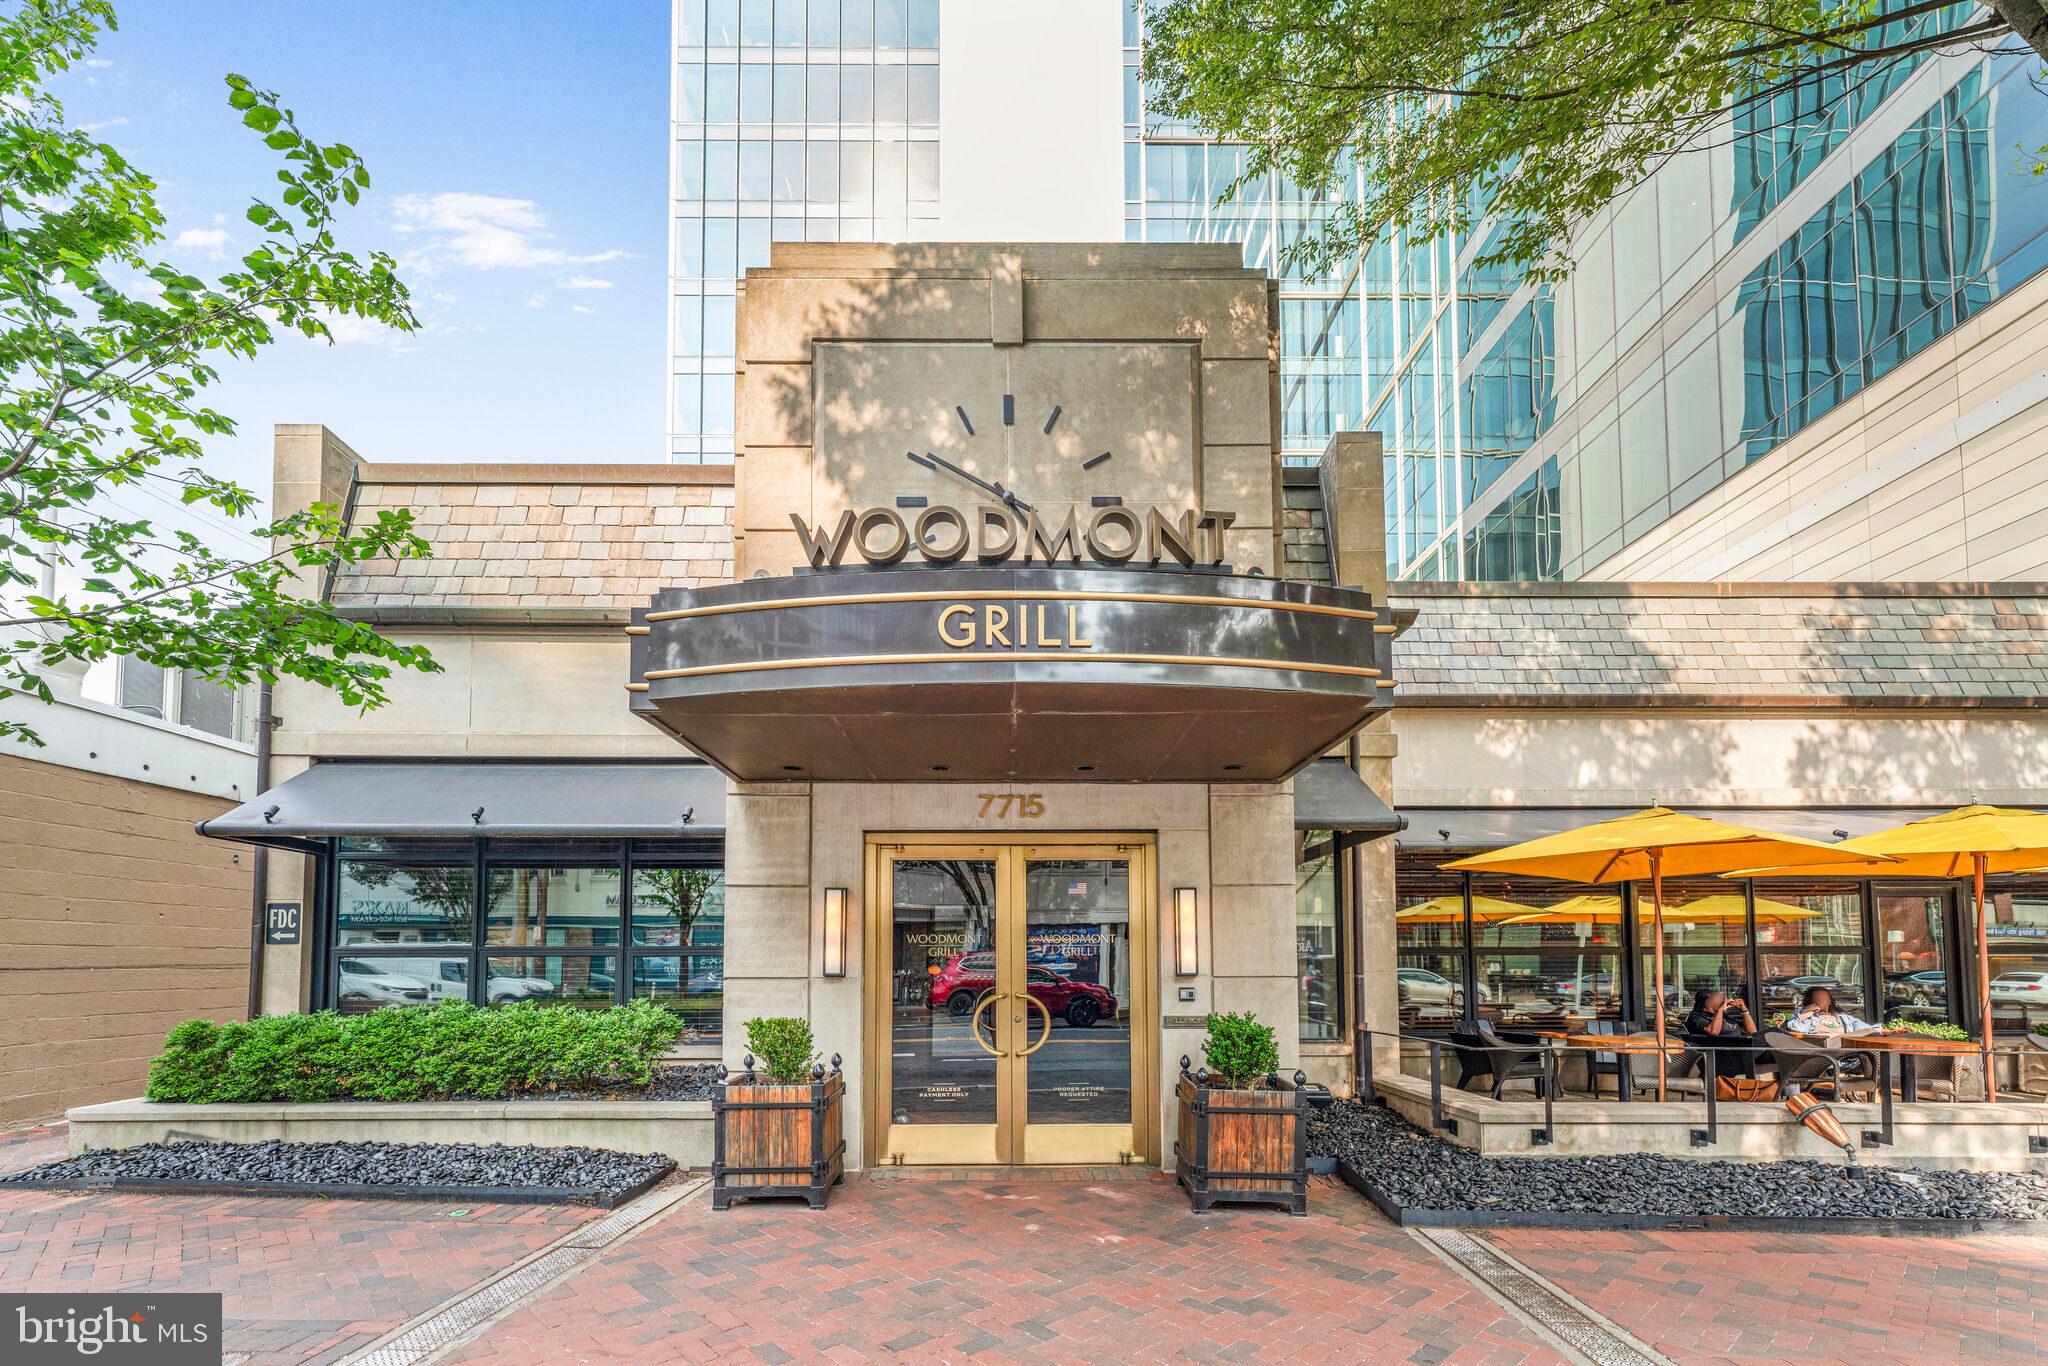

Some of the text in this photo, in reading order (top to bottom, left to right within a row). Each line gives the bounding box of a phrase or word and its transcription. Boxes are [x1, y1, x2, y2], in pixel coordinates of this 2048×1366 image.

[789, 504, 1236, 567] WOODMONT
[936, 603, 1093, 649] GRILL
[977, 793, 1046, 819] 7715
[270, 908, 297, 929] FDC
[906, 934, 983, 944] WOODMONT
[1040, 934, 1116, 944] WOODMONT
[928, 947, 960, 957] GRILL
[1062, 947, 1093, 957] GRILL
